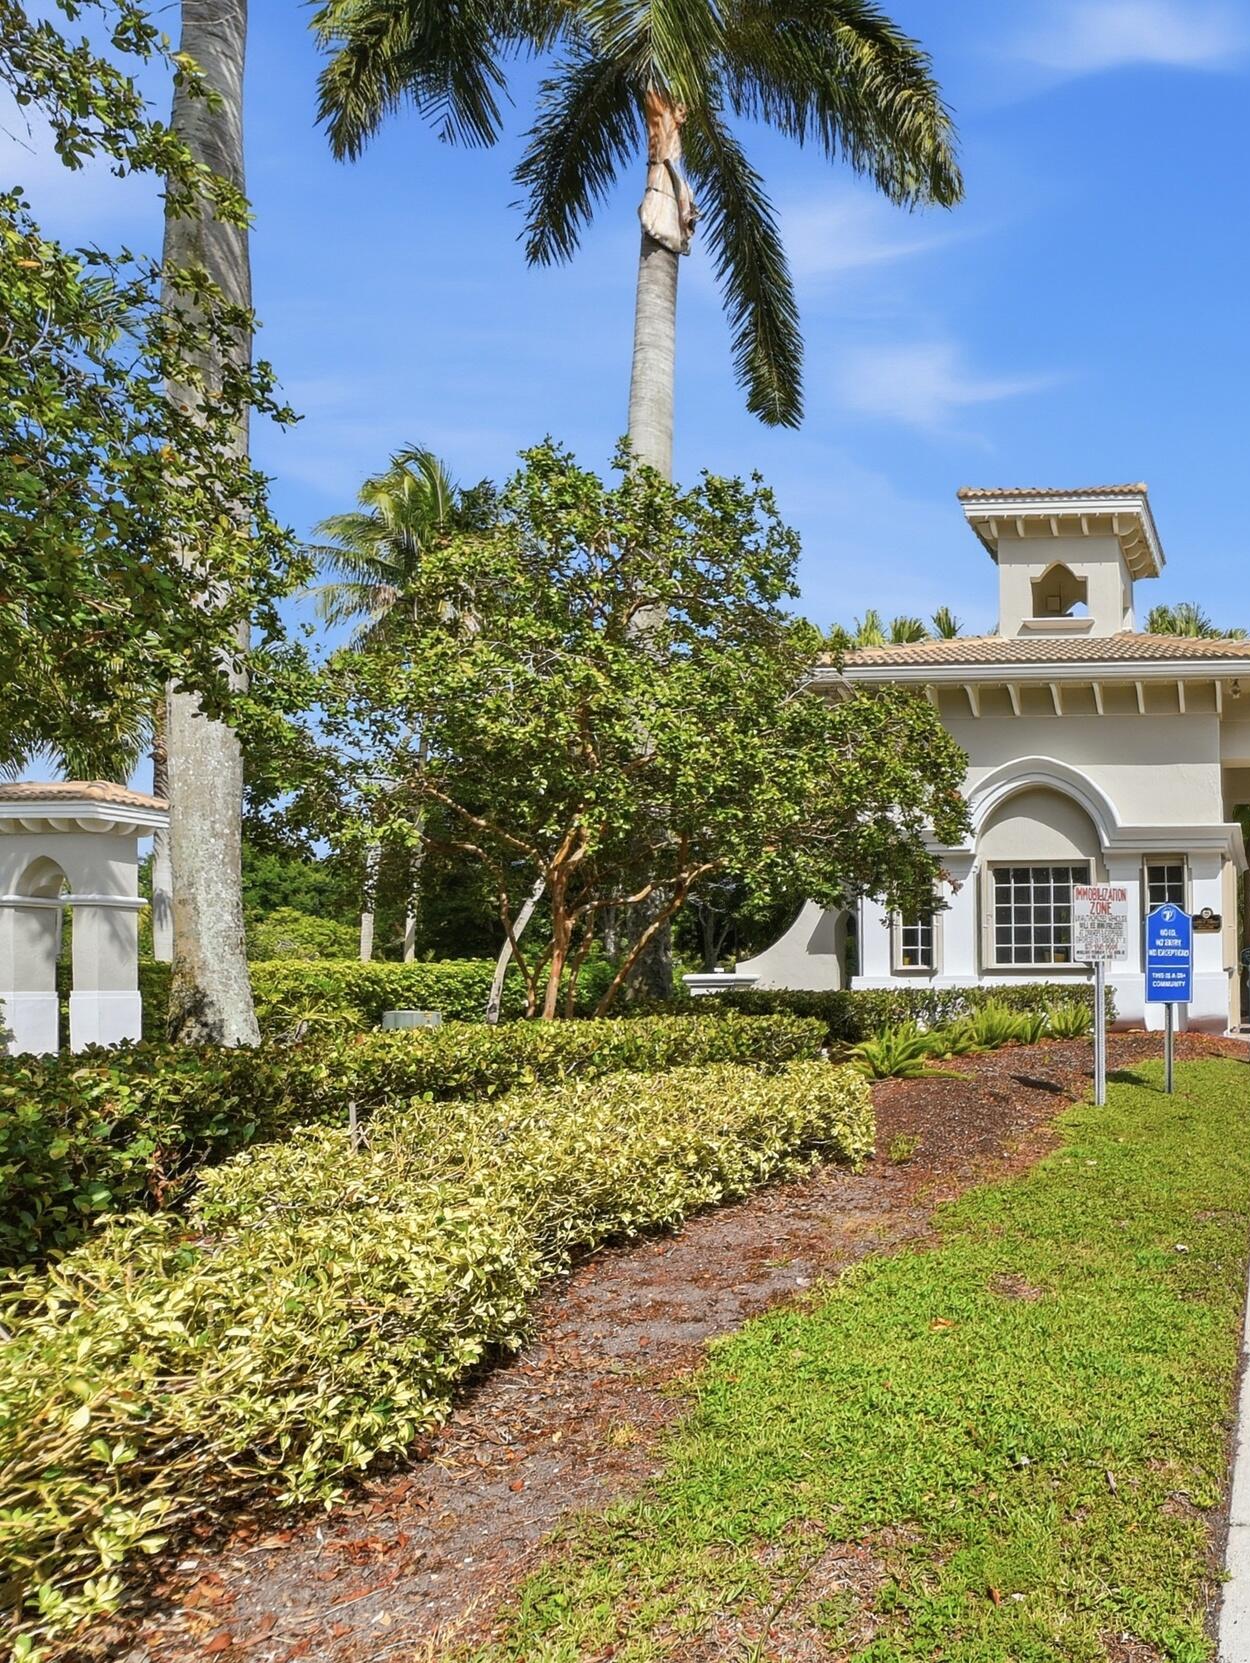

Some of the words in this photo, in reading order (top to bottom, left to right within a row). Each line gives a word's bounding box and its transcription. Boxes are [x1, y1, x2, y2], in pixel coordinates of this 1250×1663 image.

[1075, 887, 1127, 902] IMMOBILIZATION
[1090, 901, 1112, 915] ZONE
[1165, 939, 1182, 947] ENTRY
[1158, 949, 1189, 957] EXCEPTIONS
